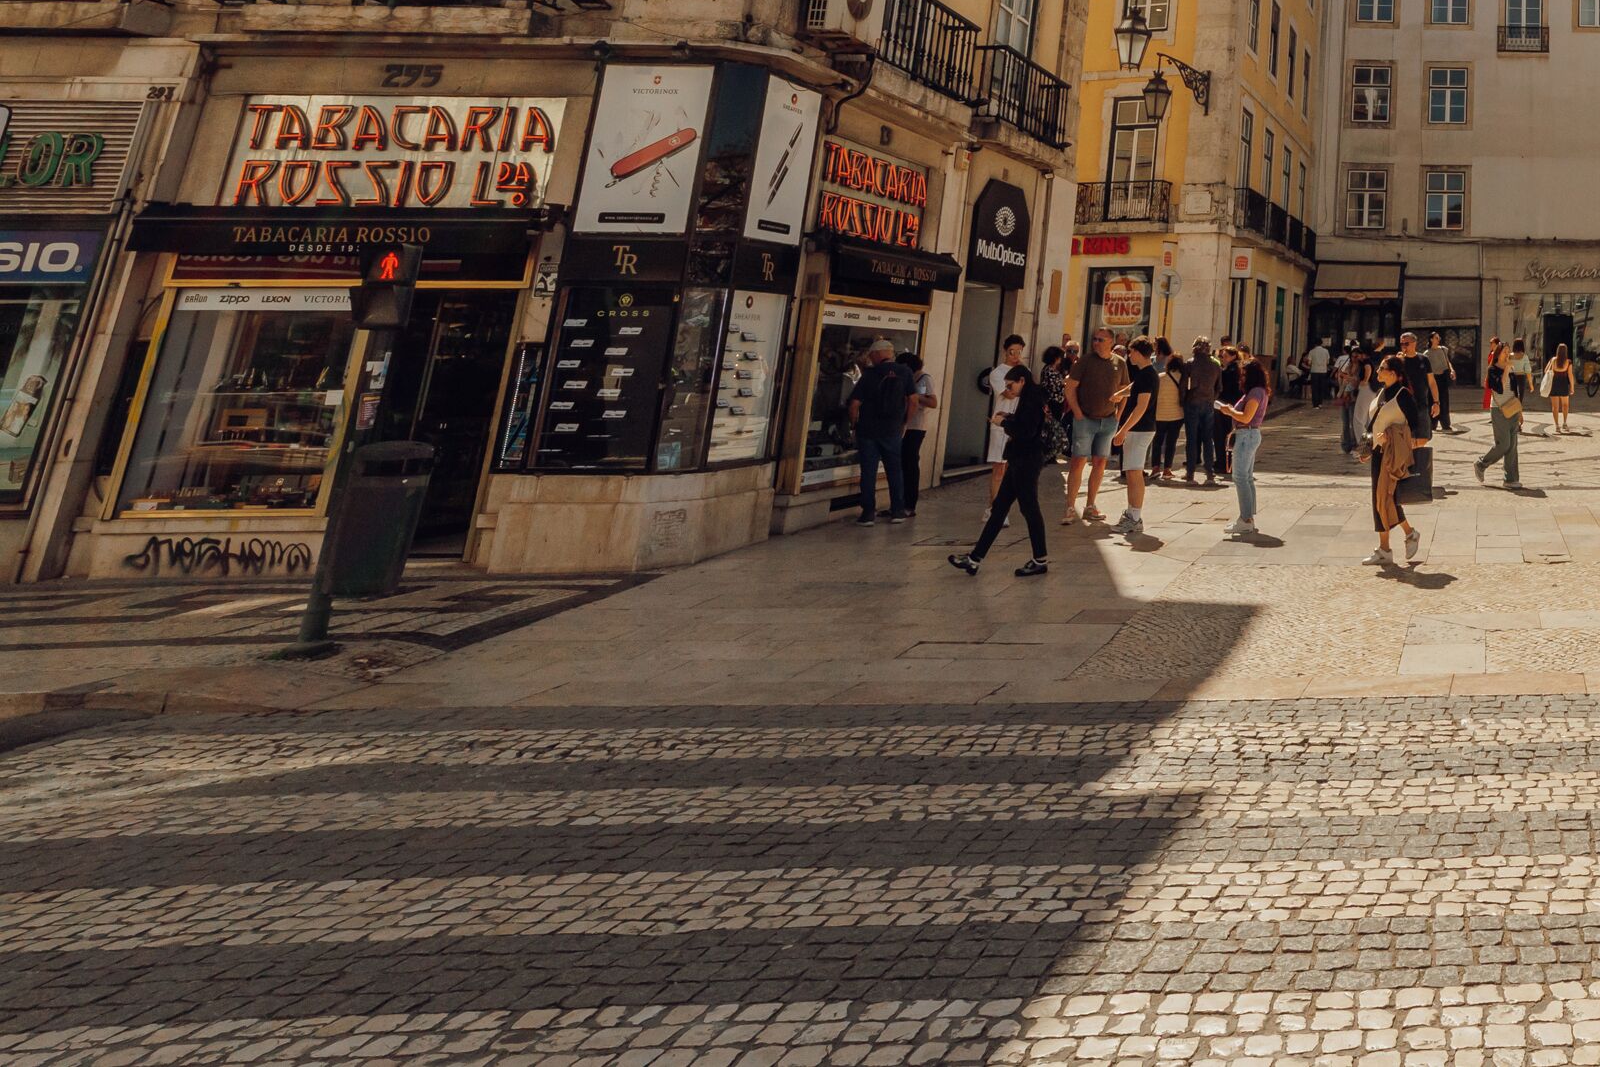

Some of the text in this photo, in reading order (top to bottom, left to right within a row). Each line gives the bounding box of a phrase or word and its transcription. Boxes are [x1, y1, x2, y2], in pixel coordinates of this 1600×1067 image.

[381, 64, 444, 88] 295
[249, 104, 555, 152] TABACARIA
[234, 160, 457, 207] ROSSIO
[824, 140, 928, 208] TABACARIA
[821, 191, 894, 244] ROSSIO
[232, 227, 431, 243] TABACARIA ROSSIO
[1083, 236, 1131, 255] KING
[219, 295, 250, 304] Zippo
[261, 295, 292, 303] LEXON
[1105, 292, 1142, 302] BURGER
[1105, 303, 1142, 316] KING
